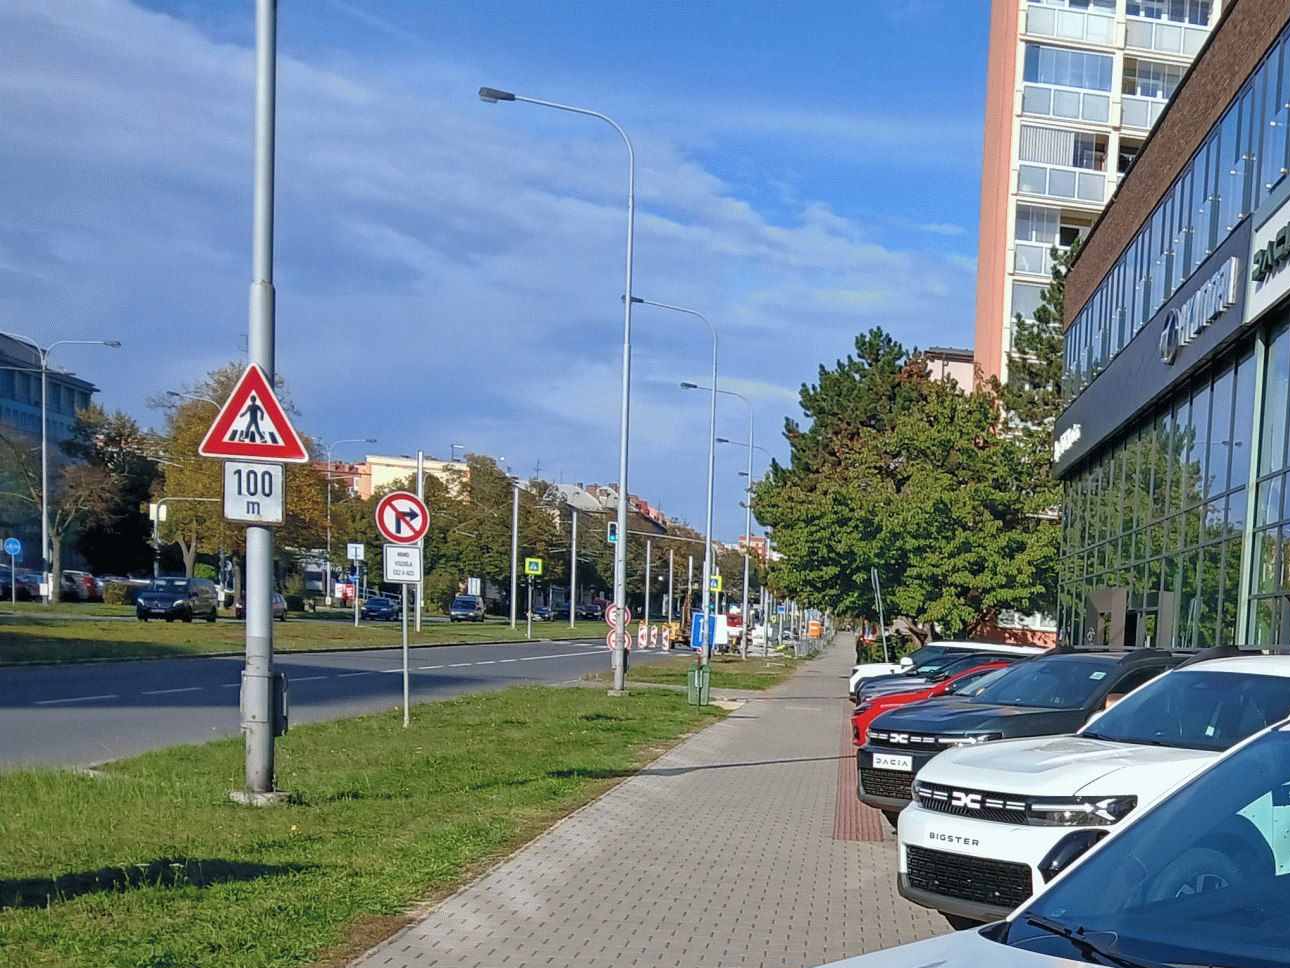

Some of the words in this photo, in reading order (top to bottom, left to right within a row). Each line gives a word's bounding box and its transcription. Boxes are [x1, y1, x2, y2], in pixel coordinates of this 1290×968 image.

[234, 469, 272, 497] 100
[247, 501, 261, 515] m
[876, 757, 908, 767] DACIA
[929, 831, 980, 846] BIGSTER
